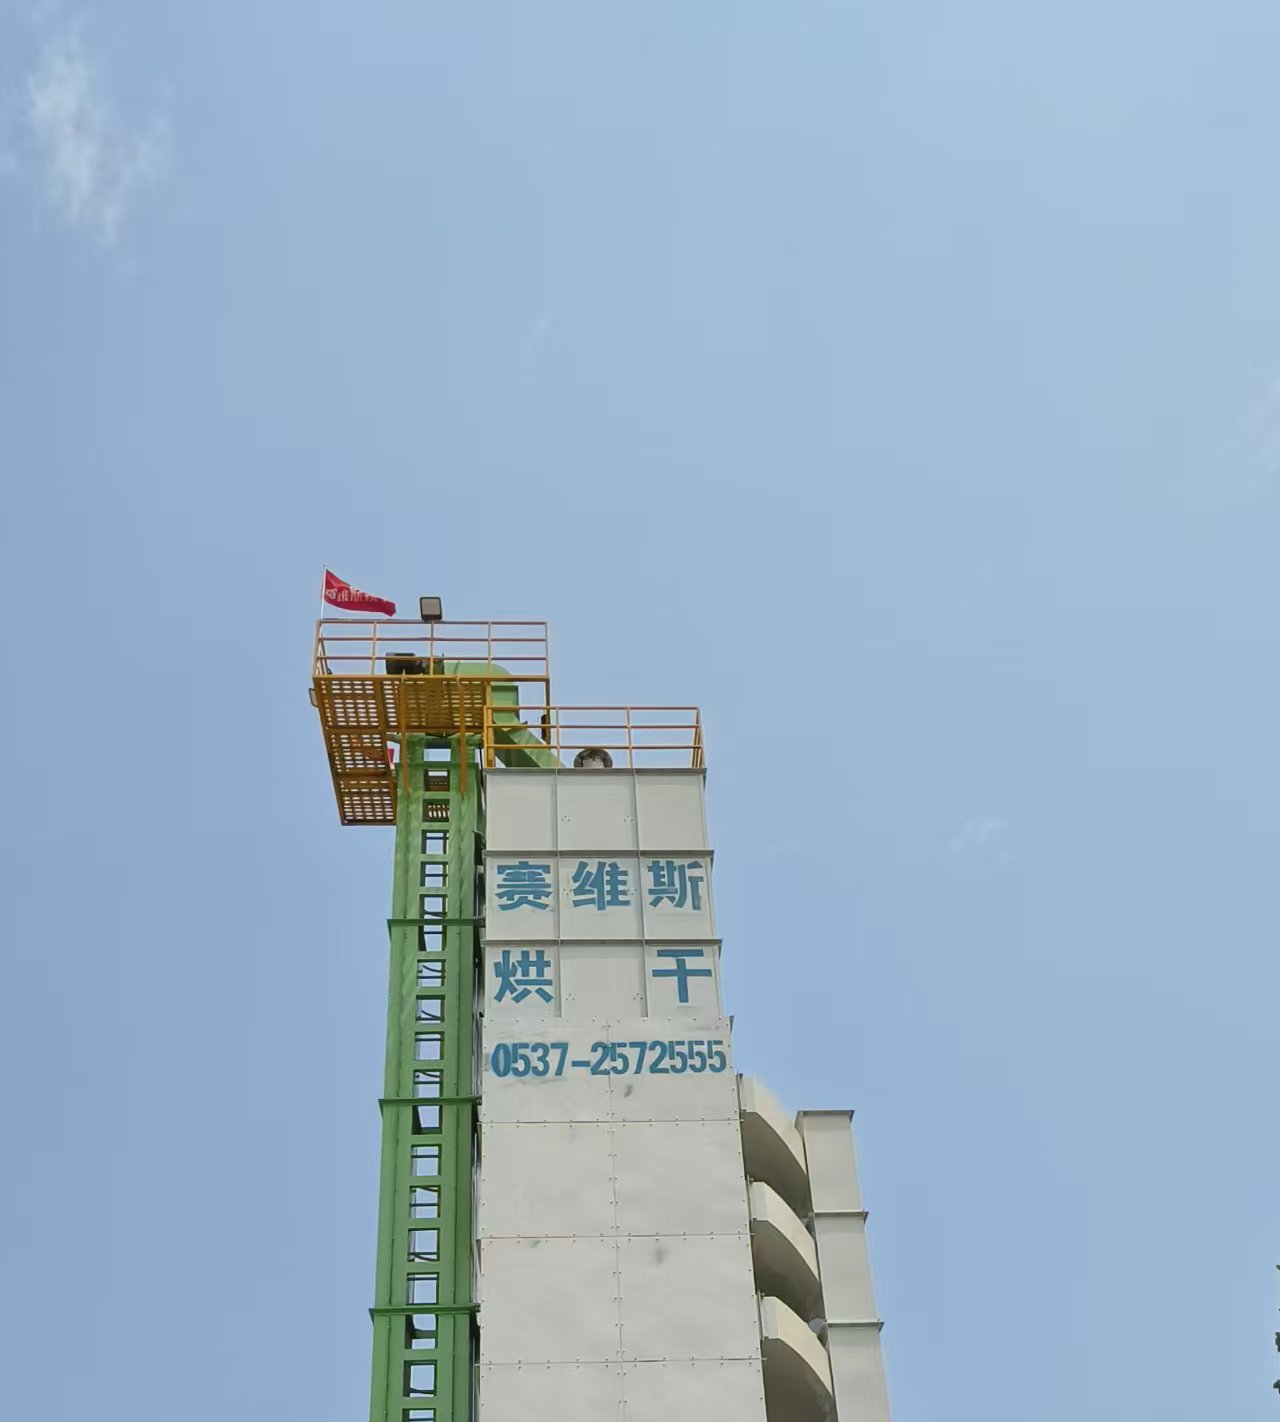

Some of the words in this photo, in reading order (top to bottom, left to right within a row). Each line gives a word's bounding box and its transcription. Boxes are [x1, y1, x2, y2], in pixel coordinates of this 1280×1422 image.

[495, 861, 704, 911] 赛维斯
[491, 1040, 727, 1078] 0537-2572555
